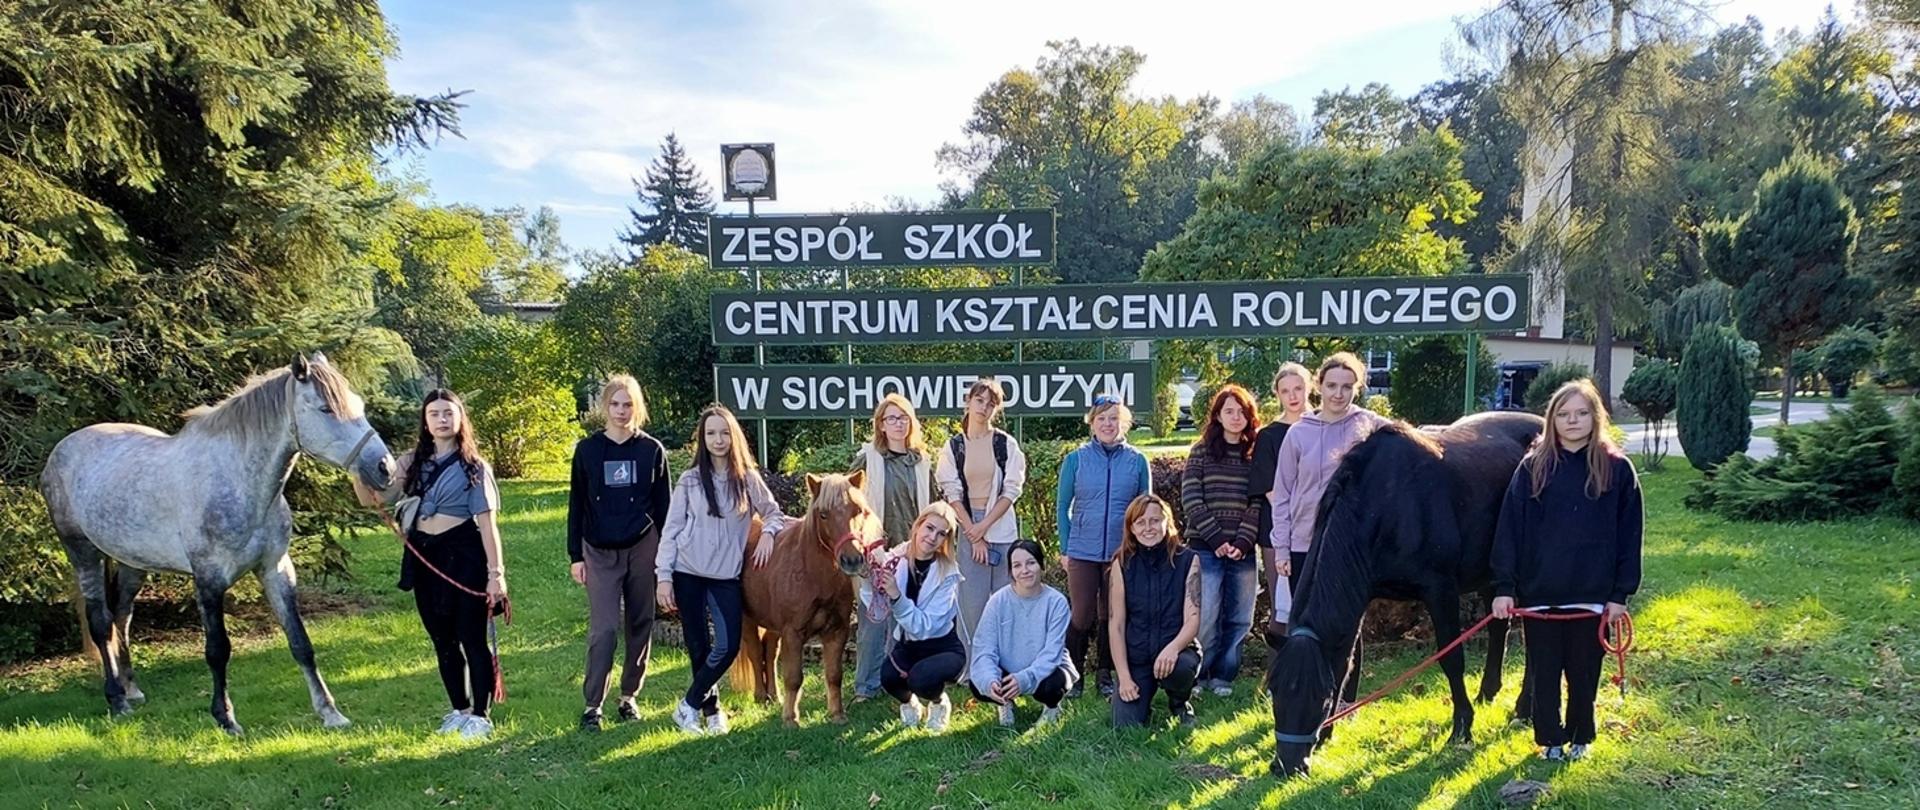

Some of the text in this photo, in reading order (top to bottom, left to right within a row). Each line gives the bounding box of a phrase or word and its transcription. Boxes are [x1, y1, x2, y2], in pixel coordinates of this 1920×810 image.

[721, 214, 1041, 262] ZESPÓŁ SZKÓŁ
[724, 284, 1517, 336] CENTRUM KSZTAŁCENIA ROLNICZEGO
[731, 366, 1135, 410] W SICHOWIE DUŻYM
